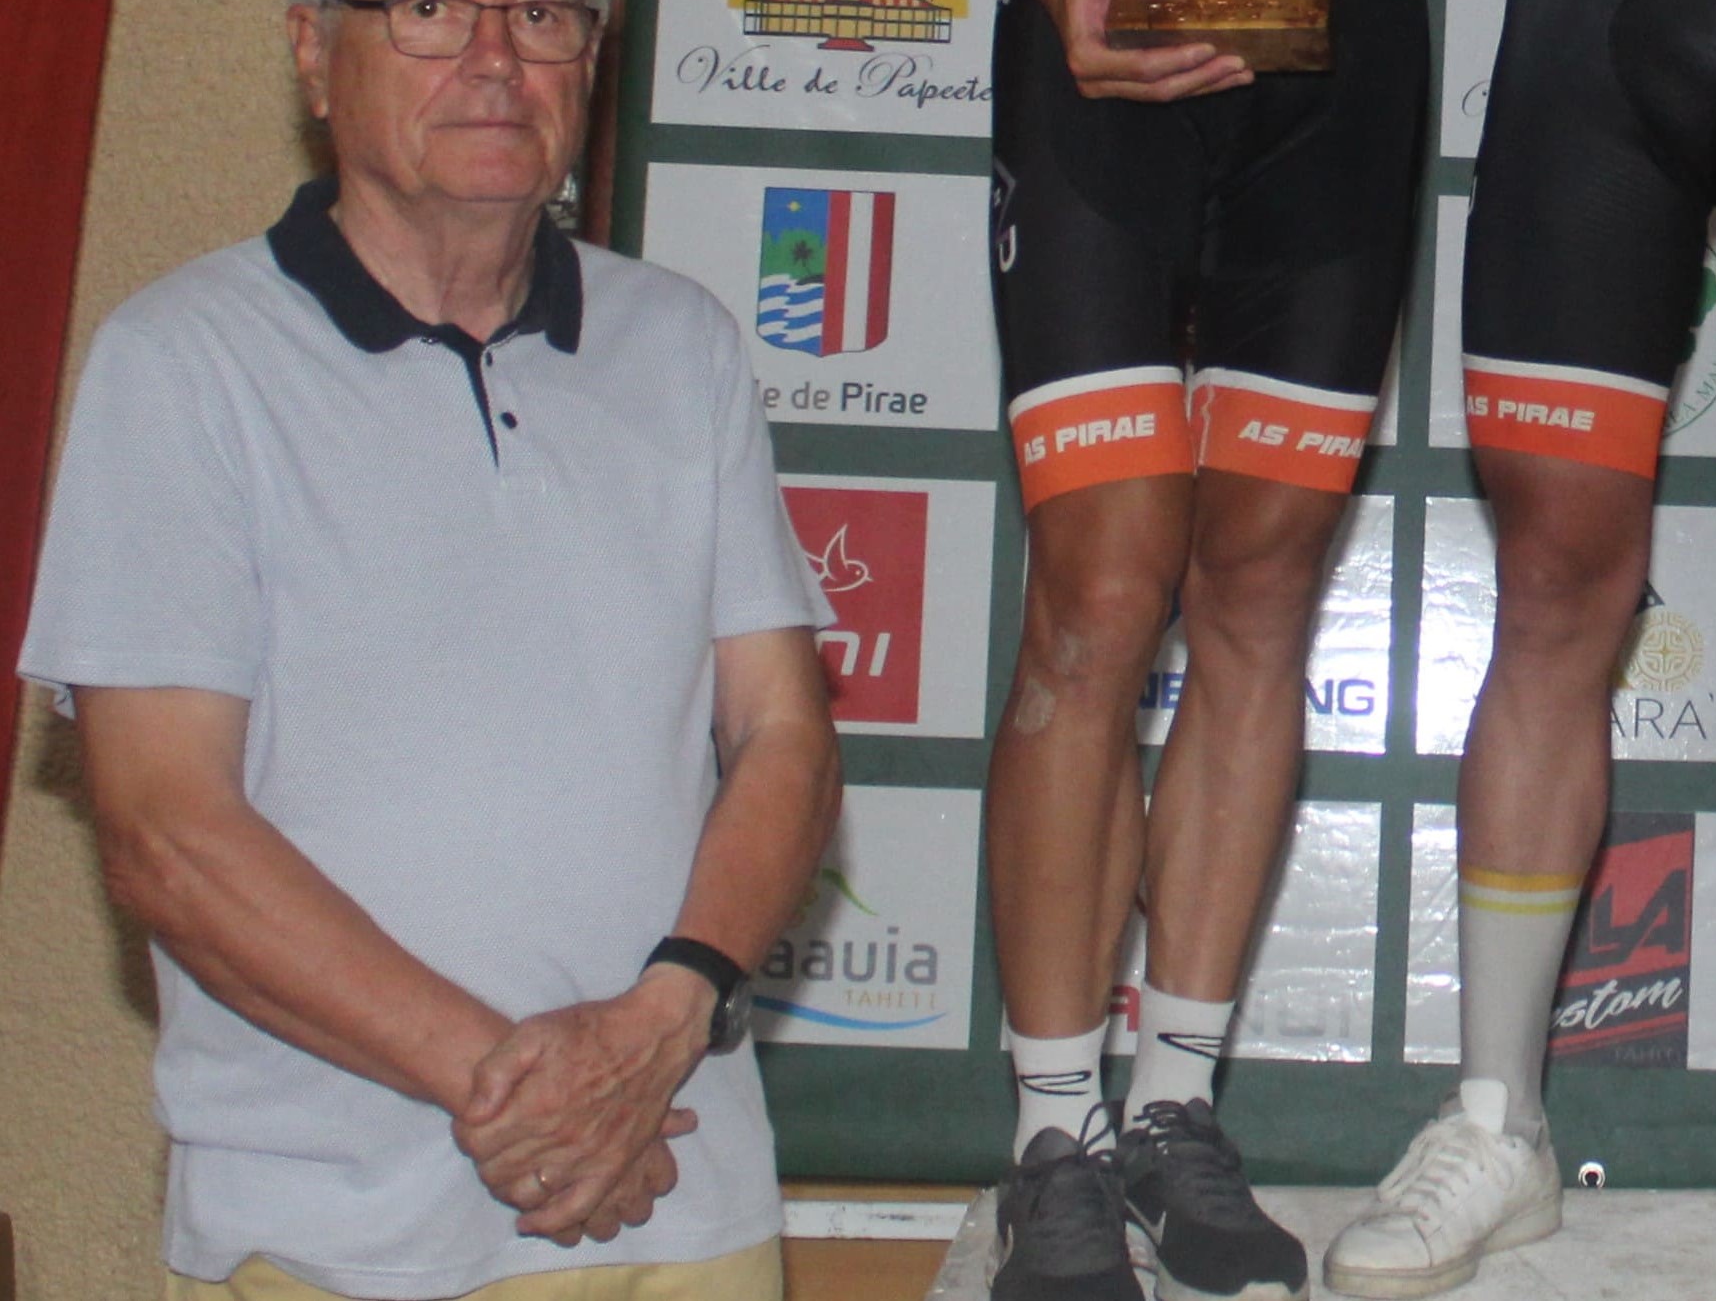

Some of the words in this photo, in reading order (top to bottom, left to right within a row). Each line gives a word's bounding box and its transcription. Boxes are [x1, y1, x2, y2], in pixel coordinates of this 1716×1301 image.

[676, 44, 786, 94] Ville
[804, 67, 839, 95] de
[855, 52, 993, 109] Papeete
[790, 381, 830, 411] de
[840, 382, 928, 415] Pirae
[1497, 400, 1596, 432] PIRAE
[1023, 442, 1046, 468] AS
[1055, 413, 1156, 453] PIRAE
[1238, 420, 1289, 448] AS
[1295, 432, 1364, 460] PIRA
[844, 989, 939, 1012] TAHITI
[1552, 976, 1684, 1030] stom
